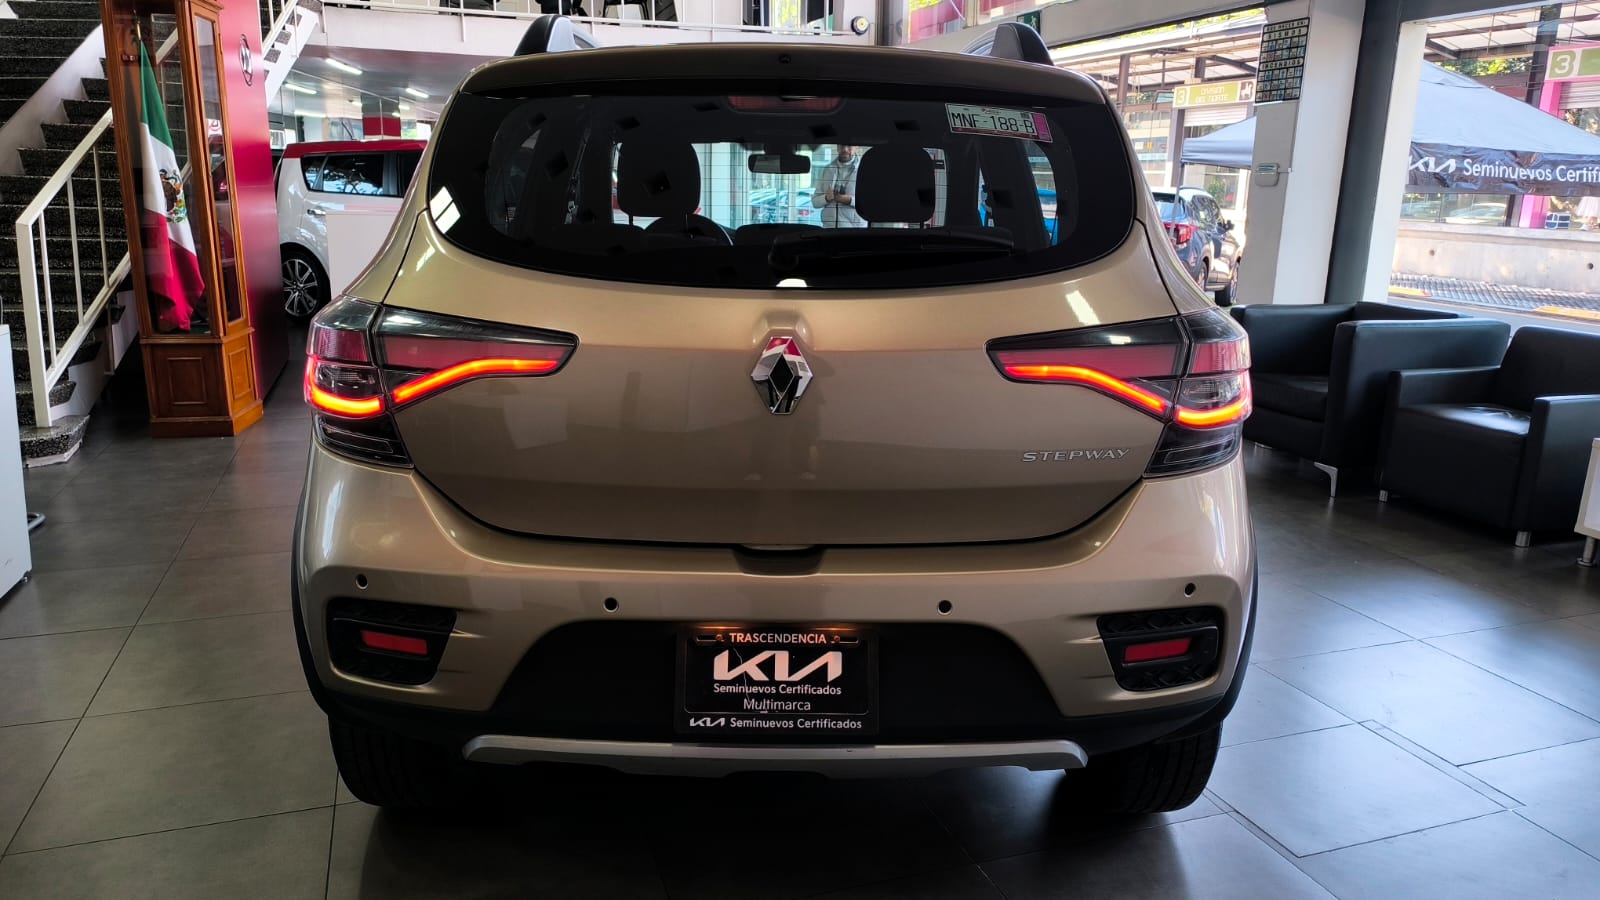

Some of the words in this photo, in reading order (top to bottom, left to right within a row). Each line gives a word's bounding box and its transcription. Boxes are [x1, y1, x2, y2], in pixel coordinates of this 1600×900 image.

[1554, 54, 1571, 74] 3
[1463, 158, 1552, 181] Seminuevos
[1022, 449, 1129, 462] STEPWAY
[729, 632, 827, 644] TRASCENDENCIA
[713, 649, 842, 682] KIA
[713, 682, 776, 694] Seminuevos
[778, 683, 842, 695] Certificados
[743, 698, 811, 711] Multimarca
[689, 717, 726, 727] KIA
[730, 717, 794, 729] Seminuevos
[797, 718, 862, 729] Certificados
